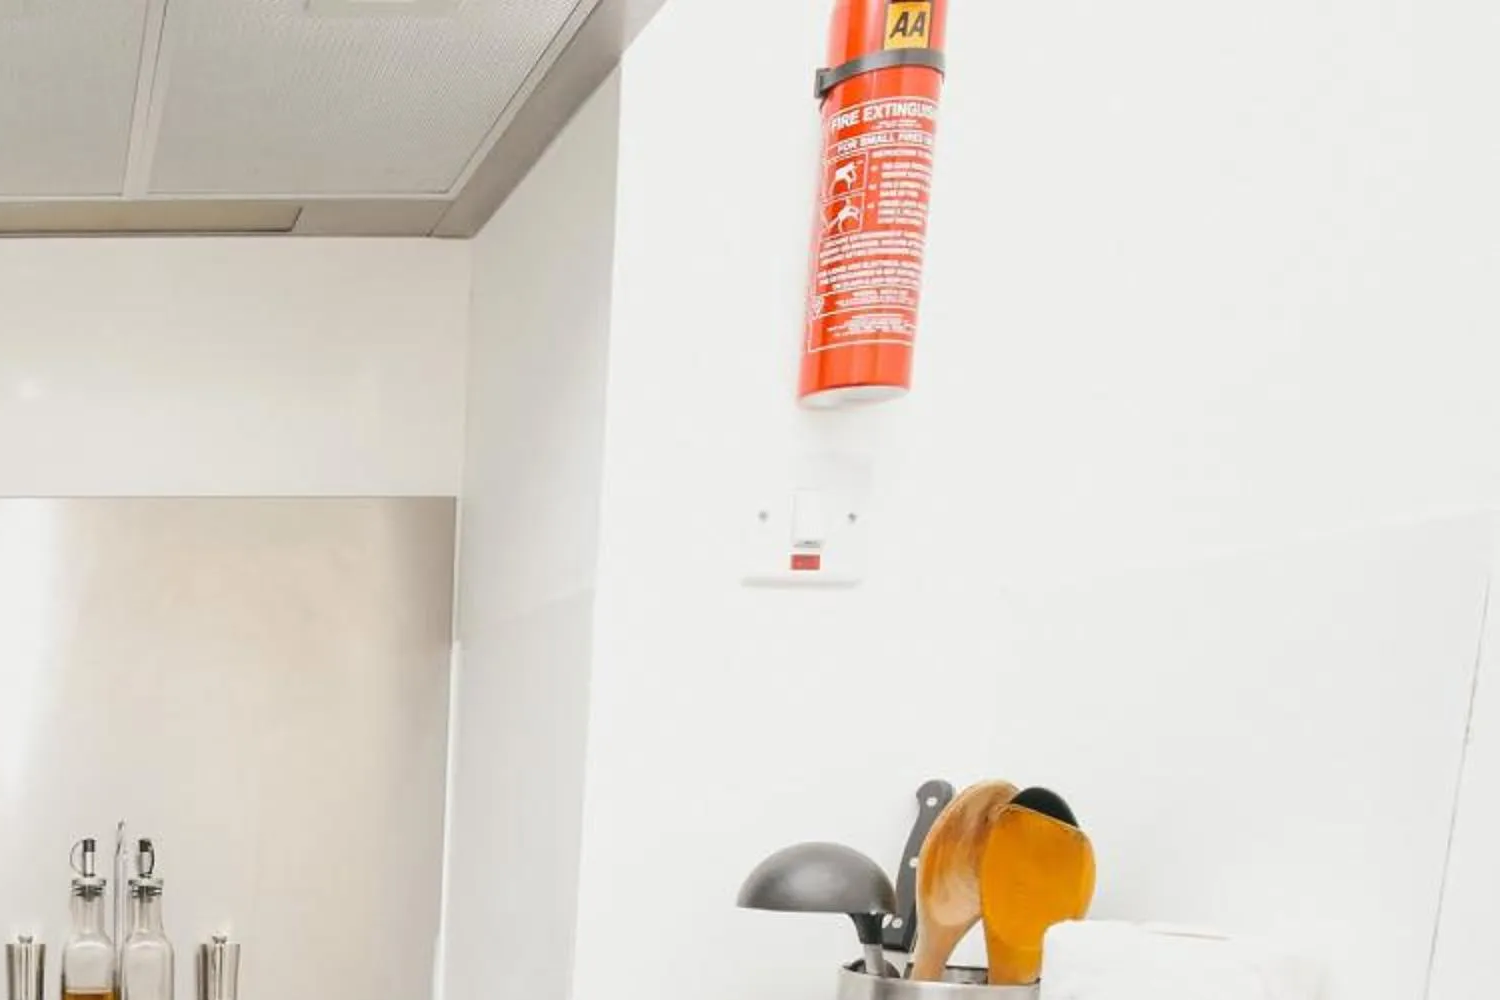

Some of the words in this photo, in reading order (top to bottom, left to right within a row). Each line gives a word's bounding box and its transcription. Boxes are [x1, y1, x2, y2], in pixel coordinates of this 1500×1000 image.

[889, 11, 926, 38] AA
[830, 109, 861, 130] FIRE
[838, 138, 858, 155] FOR
[860, 132, 893, 147] SMALL
